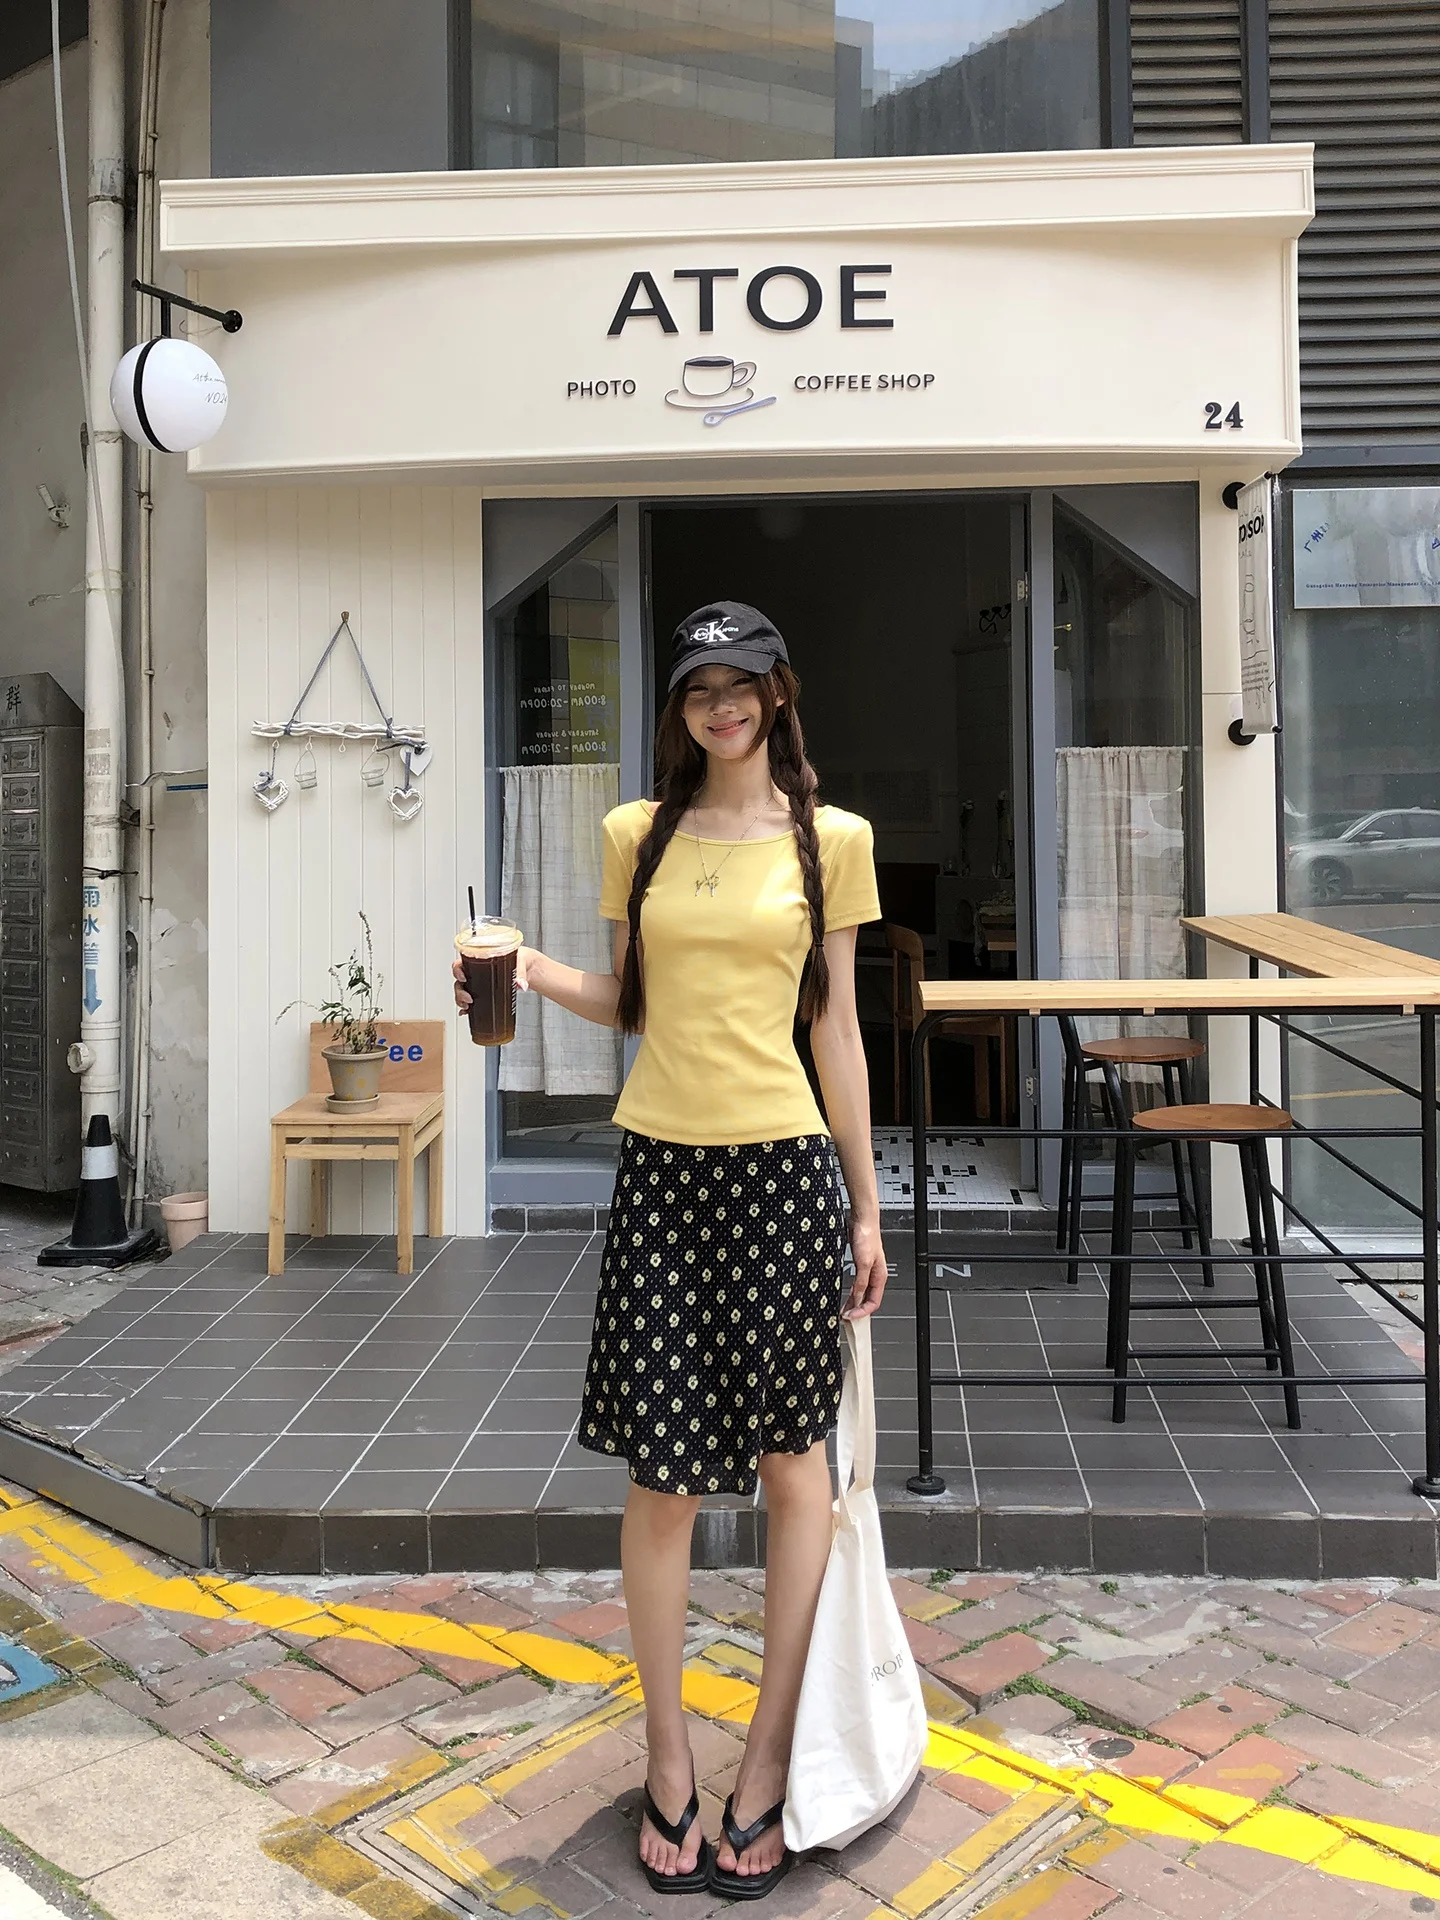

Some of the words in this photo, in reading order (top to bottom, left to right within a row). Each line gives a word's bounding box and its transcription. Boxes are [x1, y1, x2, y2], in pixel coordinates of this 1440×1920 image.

[607, 264, 894, 336] ATOE
[567, 379, 637, 397] PHOTO
[794, 374, 872, 391] COFFEE
[877, 373, 935, 390] SHOP
[1204, 401, 1244, 430] 24
